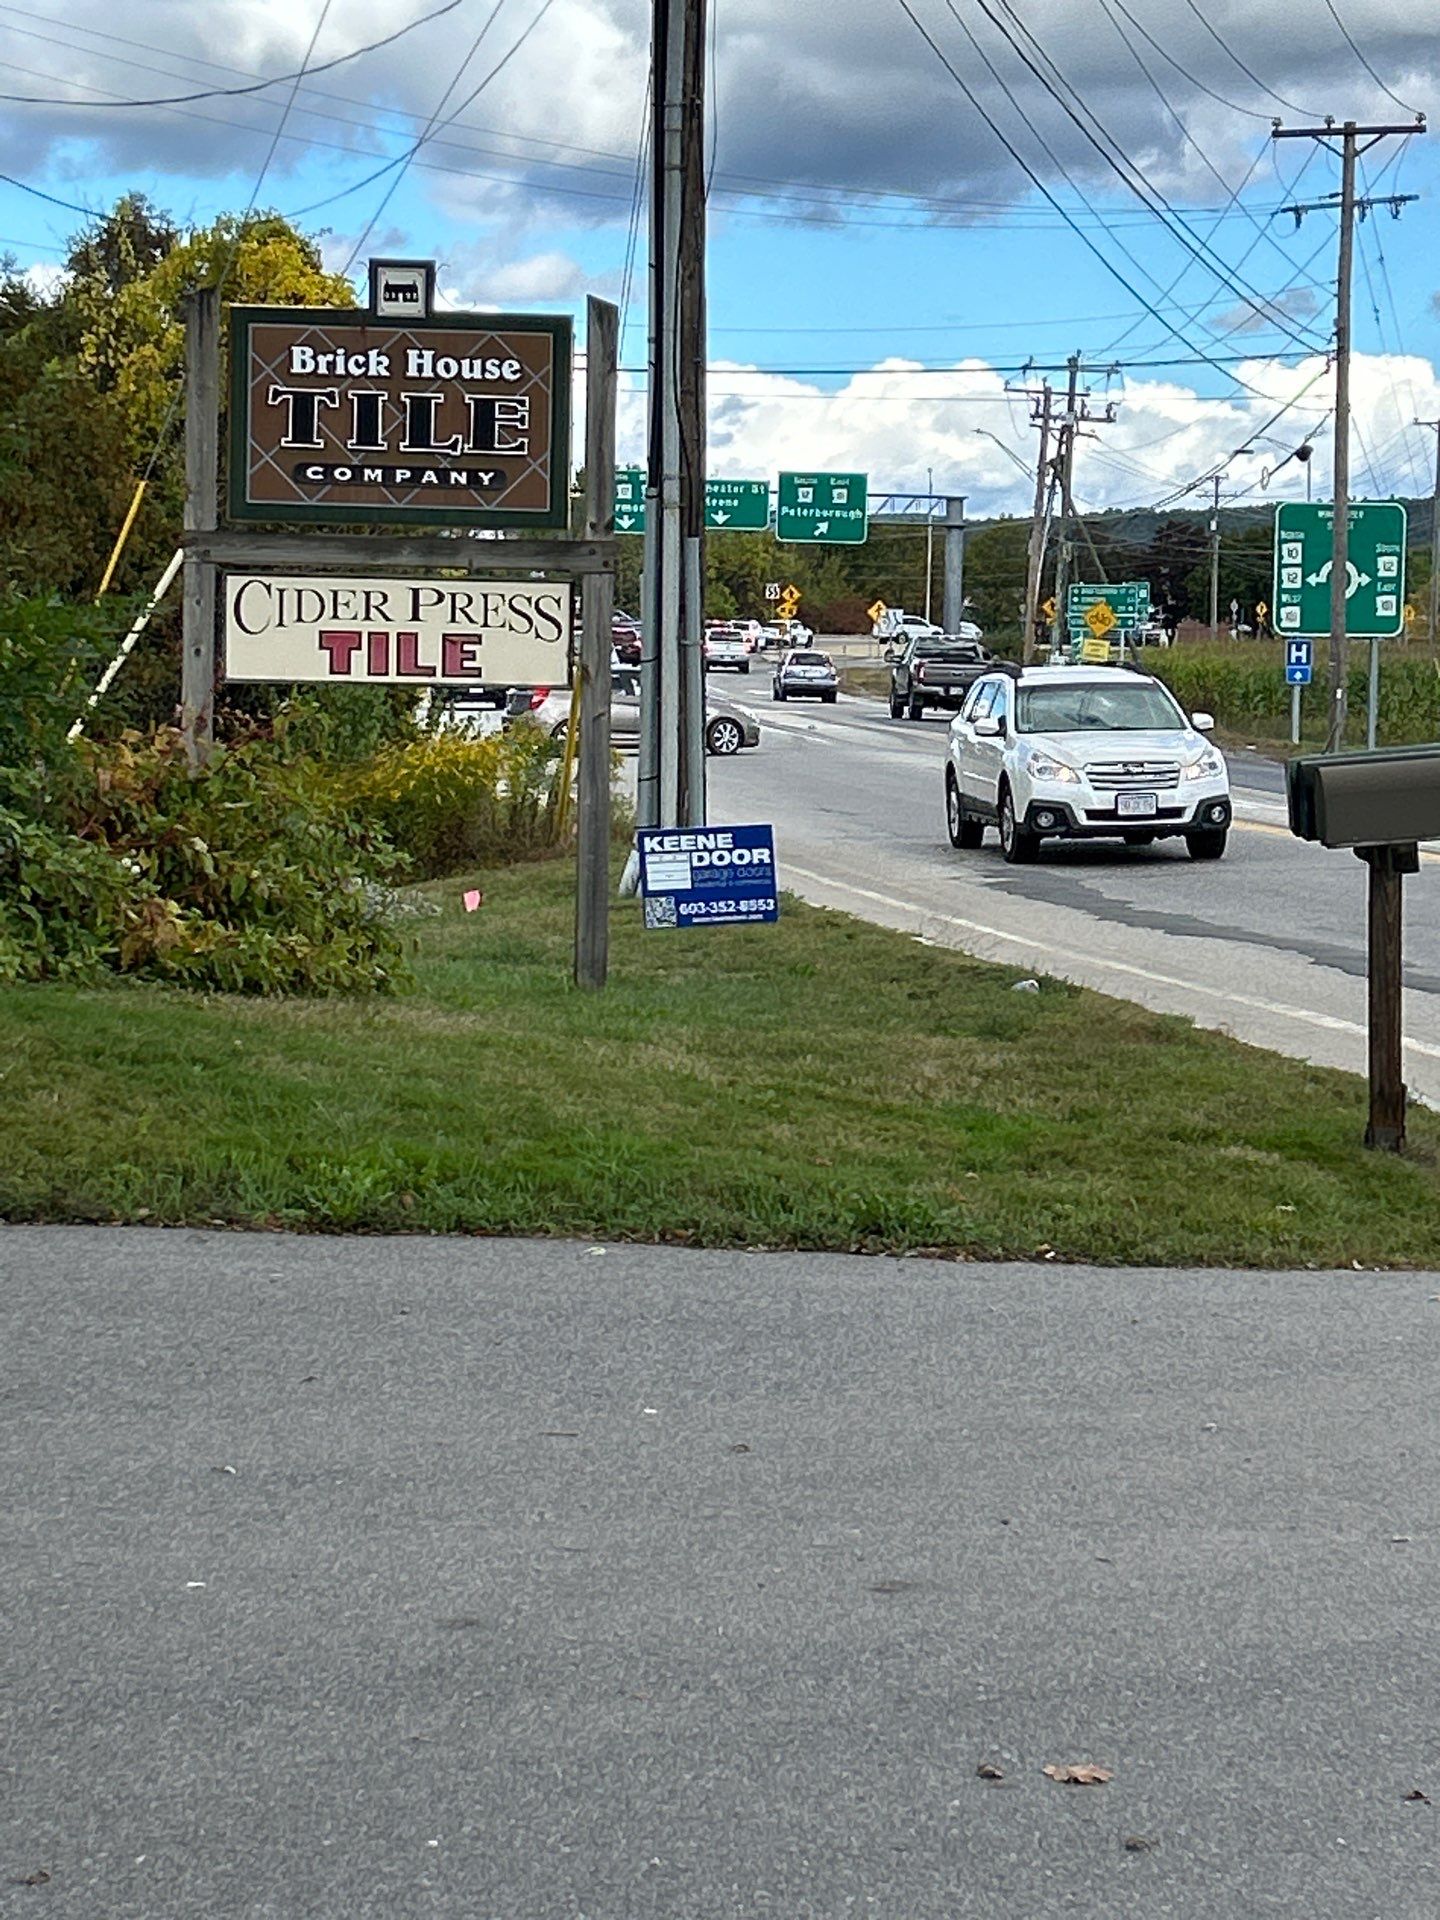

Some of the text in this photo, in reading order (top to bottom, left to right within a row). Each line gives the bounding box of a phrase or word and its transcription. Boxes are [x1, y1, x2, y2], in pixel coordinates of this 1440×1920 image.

[291, 346, 522, 381] Brick House
[268, 384, 530, 456] TILE
[306, 466, 495, 485] COMPANY
[233, 579, 563, 642] CIDER PRESS
[318, 630, 482, 678] TILE
[1290, 644, 1307, 664] H
[643, 833, 734, 852] KEENE
[692, 848, 771, 867] DOOR
